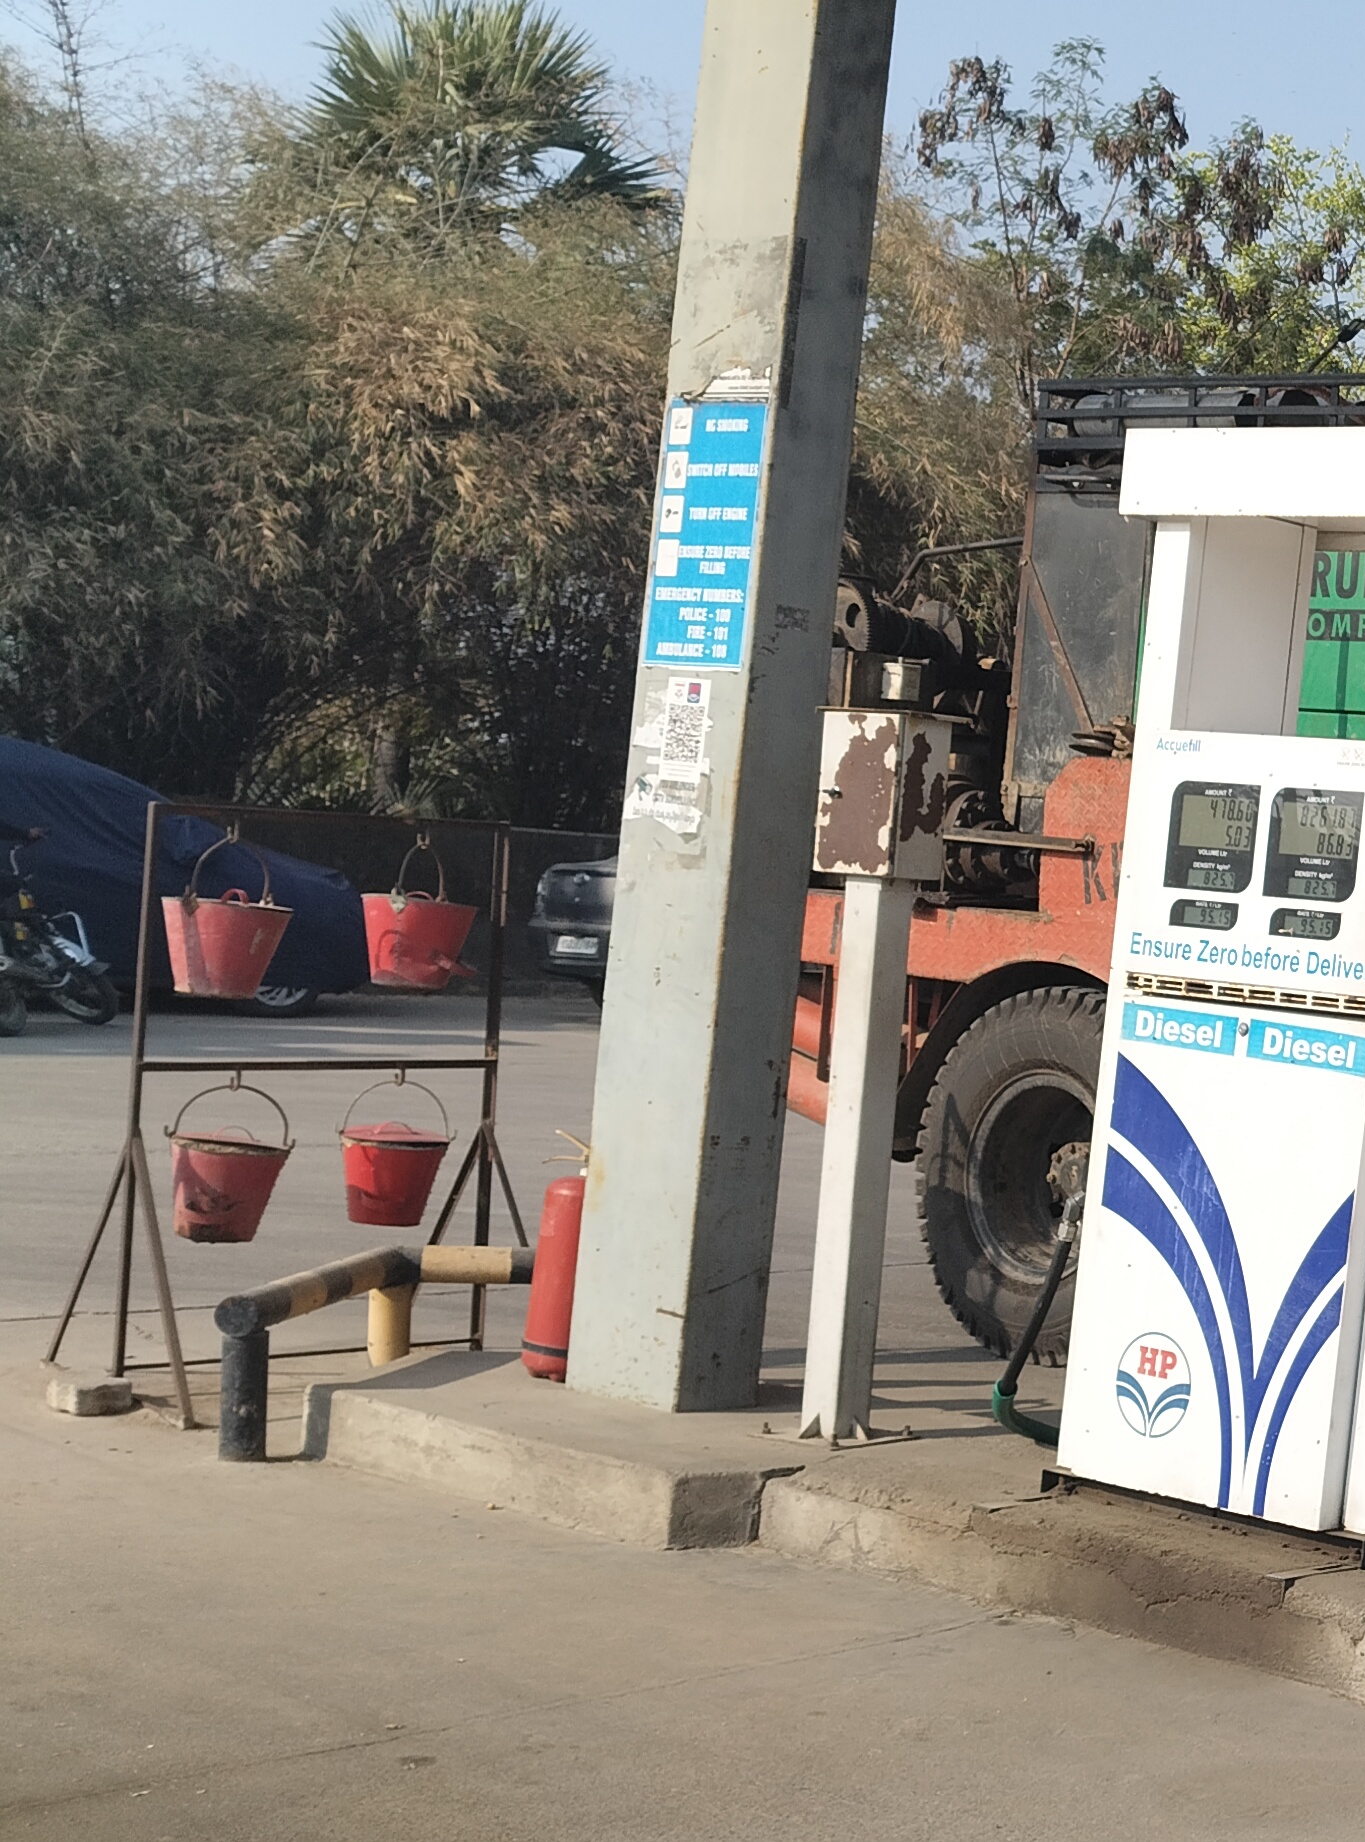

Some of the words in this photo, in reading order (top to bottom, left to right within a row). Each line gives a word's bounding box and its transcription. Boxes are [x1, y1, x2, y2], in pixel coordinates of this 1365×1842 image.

[713, 463, 728, 477] OFF
[707, 507, 722, 521] OFF
[678, 606, 708, 622] POLICE
[686, 625, 706, 640] FIRE
[1130, 931, 1192, 961] Ensure
[1196, 939, 1238, 967] Zero
[1241, 943, 1301, 972] before
[1135, 1009, 1222, 1048] Diesel
[1263, 1030, 1356, 1069] Diesel
[1137, 1345, 1178, 1380] HP
